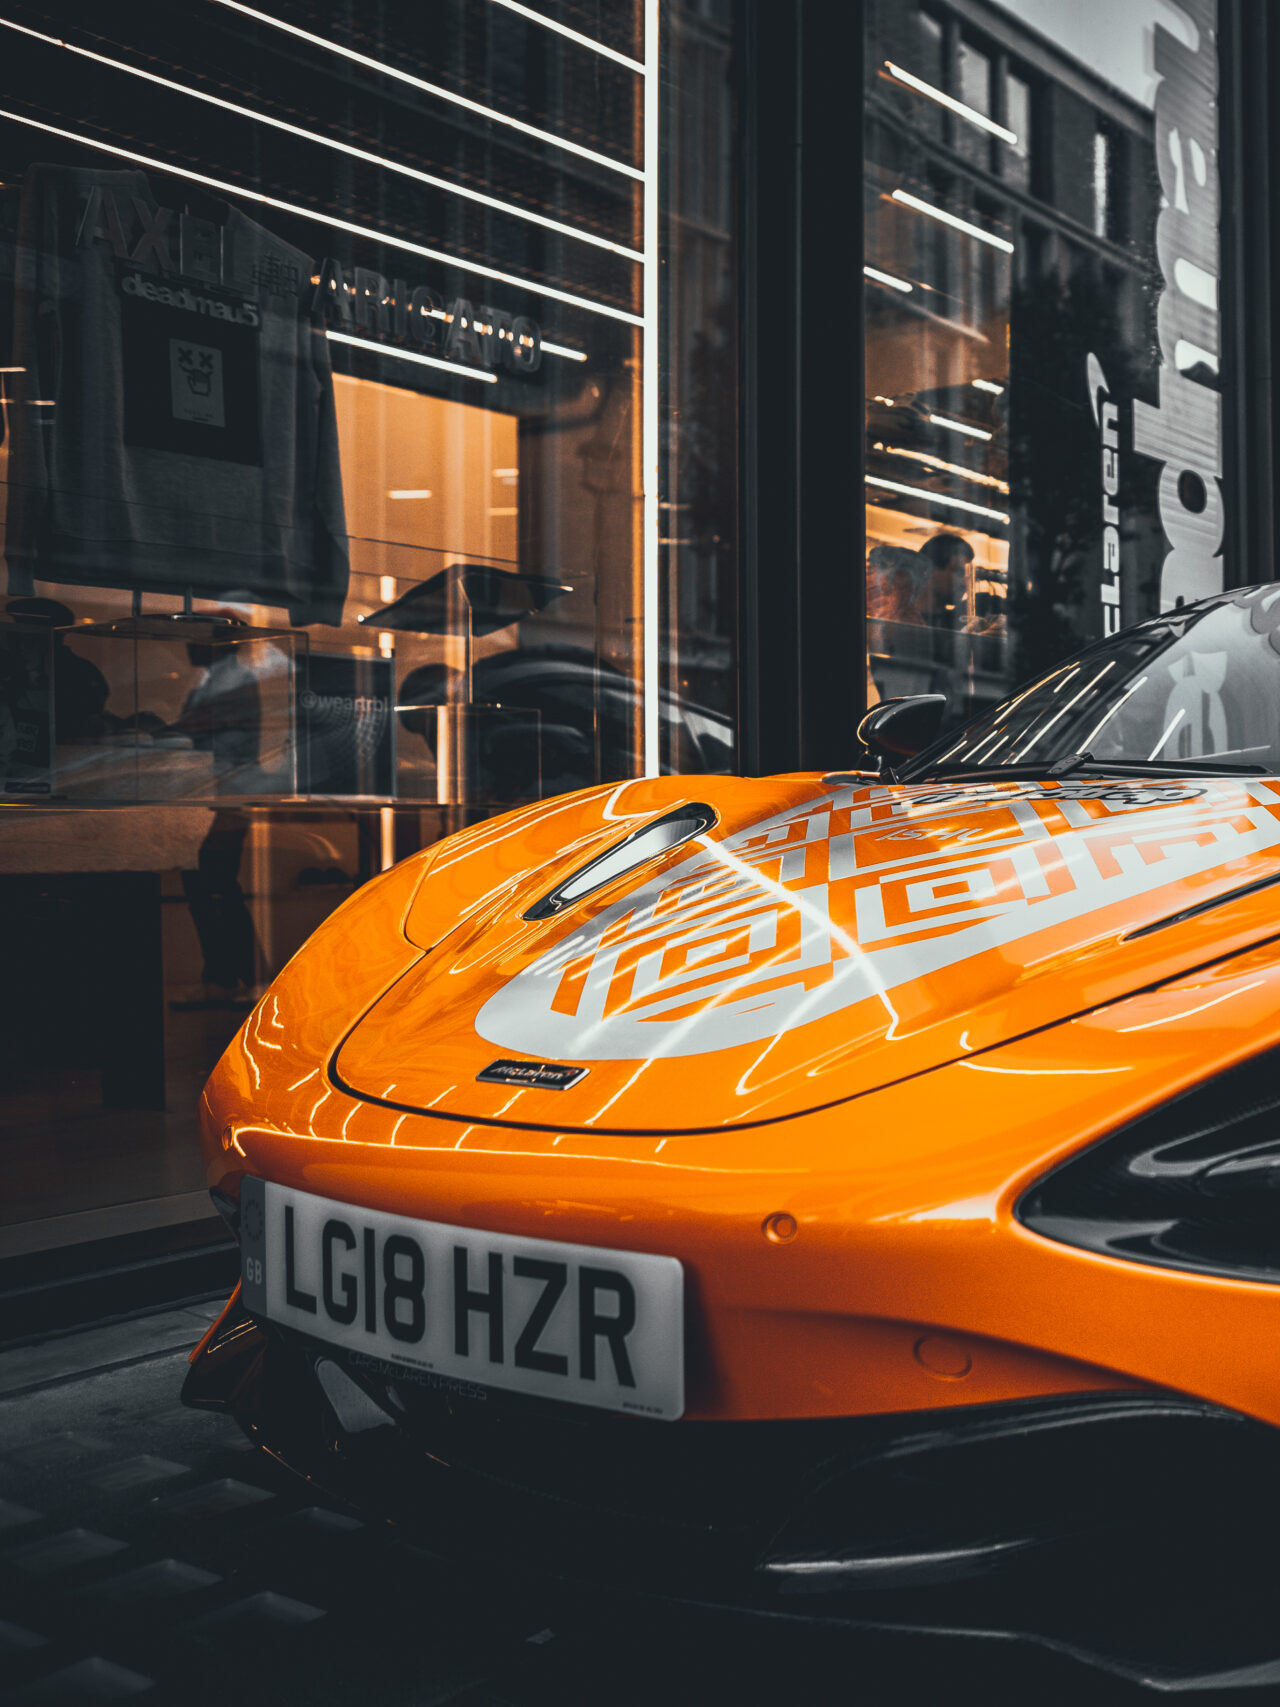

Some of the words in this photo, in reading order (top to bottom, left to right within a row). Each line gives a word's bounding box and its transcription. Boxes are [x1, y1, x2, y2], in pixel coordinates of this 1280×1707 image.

[75, 184, 248, 296] AXEL
[311, 257, 543, 374] ARIGATO
[120, 273, 260, 327] deadmau5
[246, 1256, 262, 1285] GB
[285, 1205, 425, 1344] LG18
[454, 1245, 636, 1389] HZR
